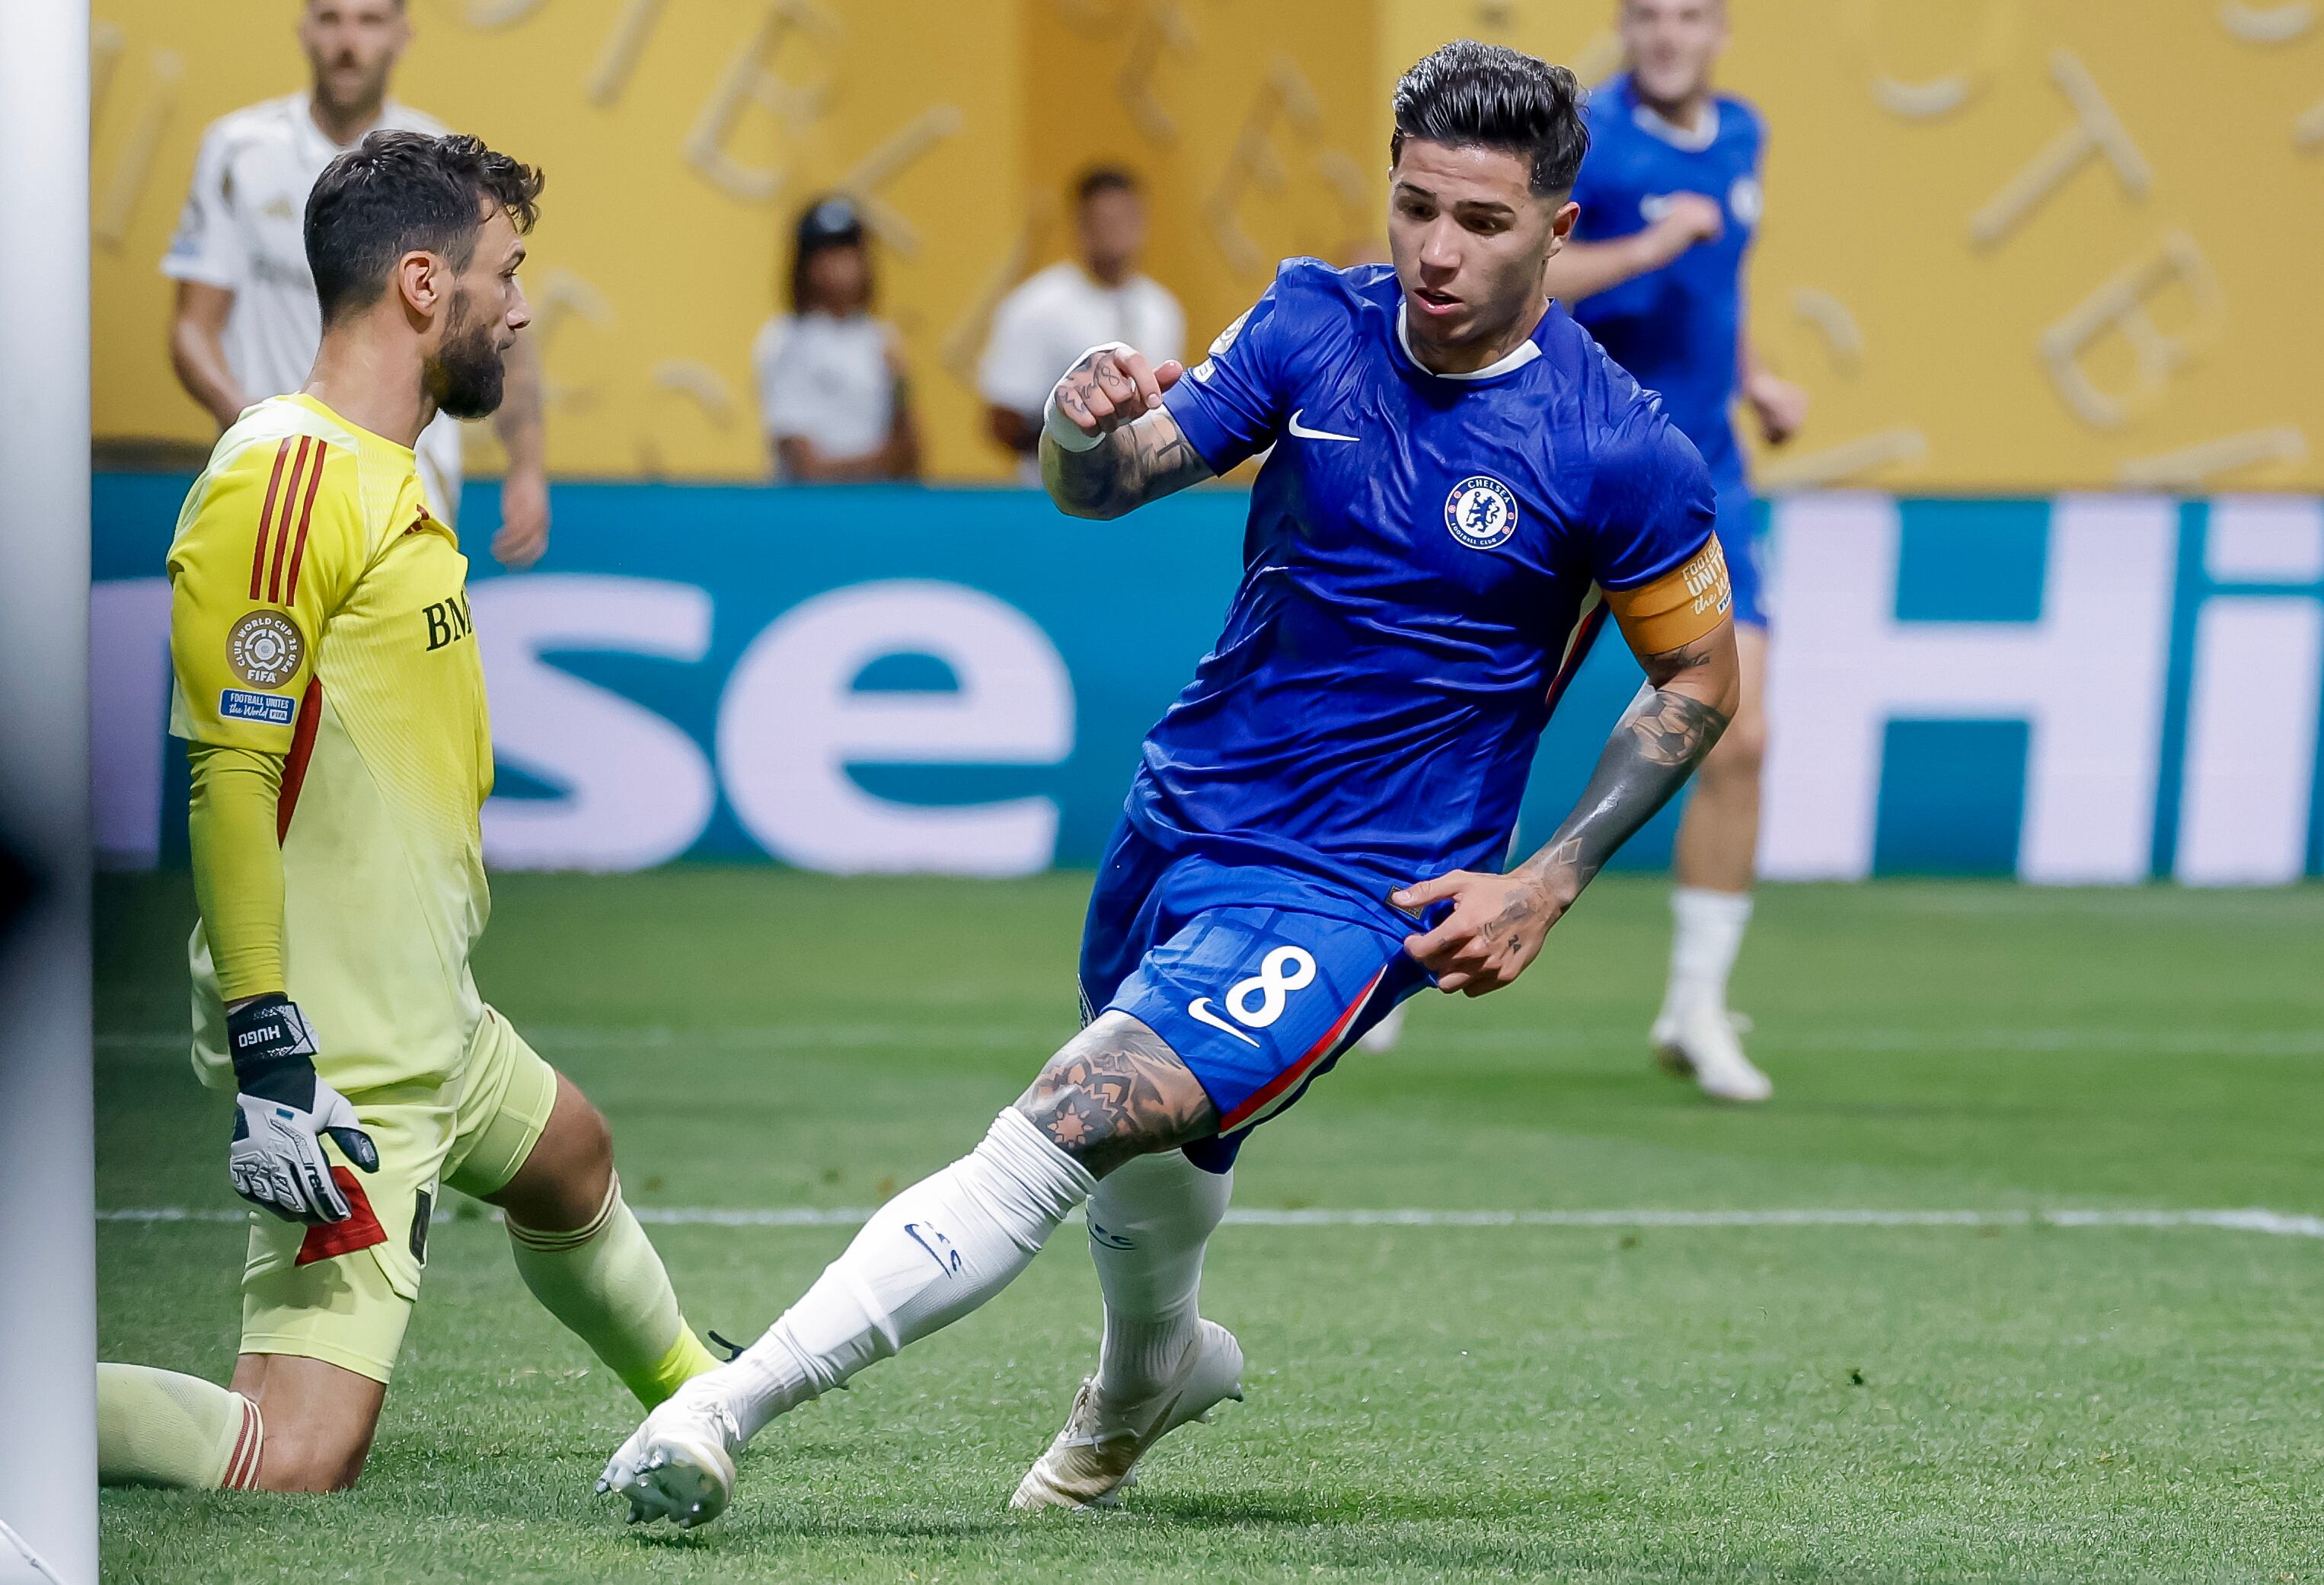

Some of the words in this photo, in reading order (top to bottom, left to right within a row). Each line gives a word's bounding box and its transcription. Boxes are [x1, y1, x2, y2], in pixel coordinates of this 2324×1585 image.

[1467, 479, 1510, 503] CHELSEA
[1451, 522, 1476, 544] FOOTBALL
[1690, 595, 1717, 615] the
[237, 617, 272, 638] WORLD
[274, 620, 292, 636] CUP
[234, 640, 246, 667] CLUB
[289, 638, 298, 651] 25
[280, 654, 296, 673] USA
[247, 669, 276, 684] FIFA
[1756, 493, 2321, 888] Hi
[228, 703, 243, 714] the
[243, 704, 269, 719] World
[270, 710, 286, 719] FIFA
[230, 692, 263, 706] FOOTBALL
[266, 697, 289, 710] UNITES
[1225, 945, 1317, 1028] 8
[238, 1024, 282, 1048] HUGO
